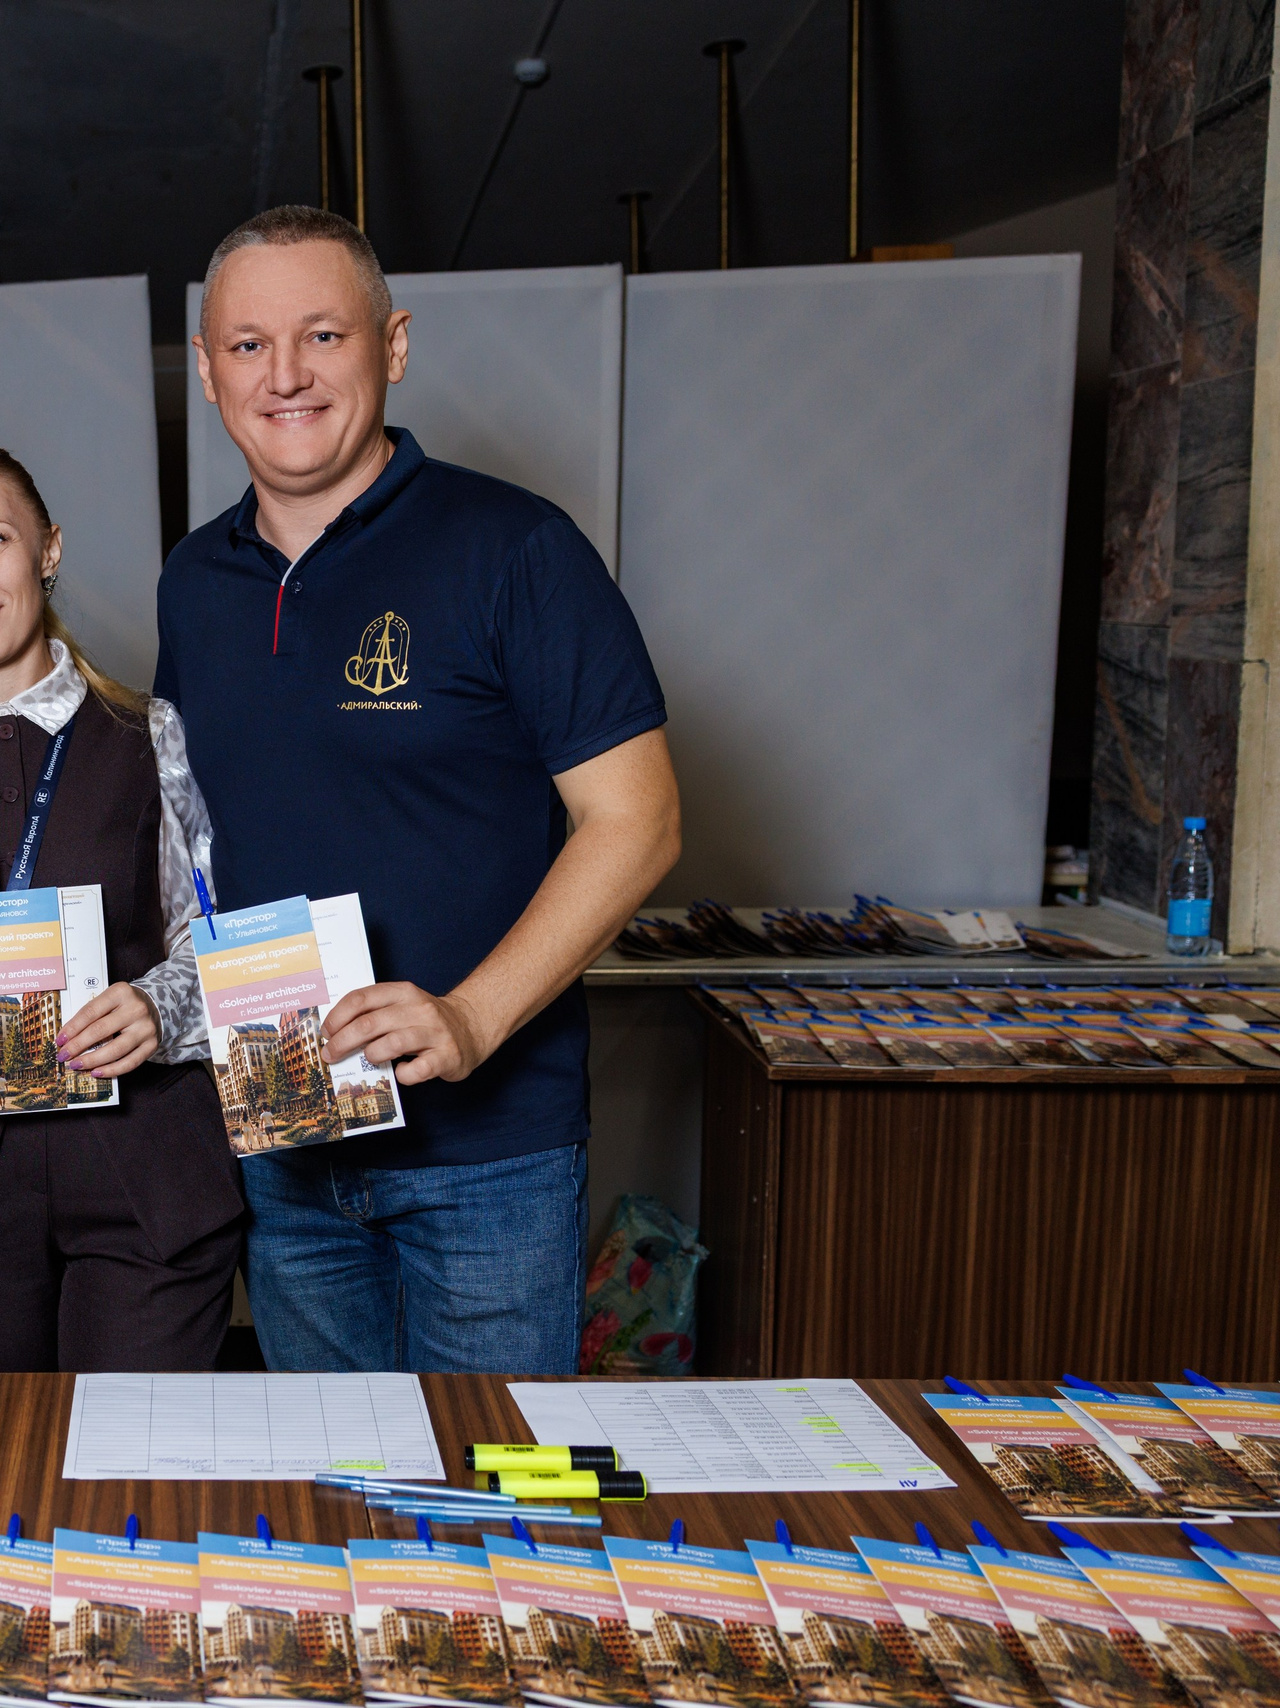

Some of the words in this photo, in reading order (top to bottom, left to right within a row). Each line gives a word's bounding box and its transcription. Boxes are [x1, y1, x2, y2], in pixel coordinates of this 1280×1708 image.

[43, 734, 65, 781] Калининград
[37, 791, 48, 804] RE
[224, 911, 278, 929] «Простор»
[16, 930, 54, 941] проект»
[235, 923, 278, 940] Ульяновск
[209, 951, 268, 971] «Авторский
[269, 943, 309, 959] проект»
[8, 967, 56, 979] architects»
[249, 963, 280, 975] Тюмень
[219, 994, 264, 1009] «Soloviev
[266, 982, 317, 1000] architects»
[247, 998, 301, 1016] Калининград
